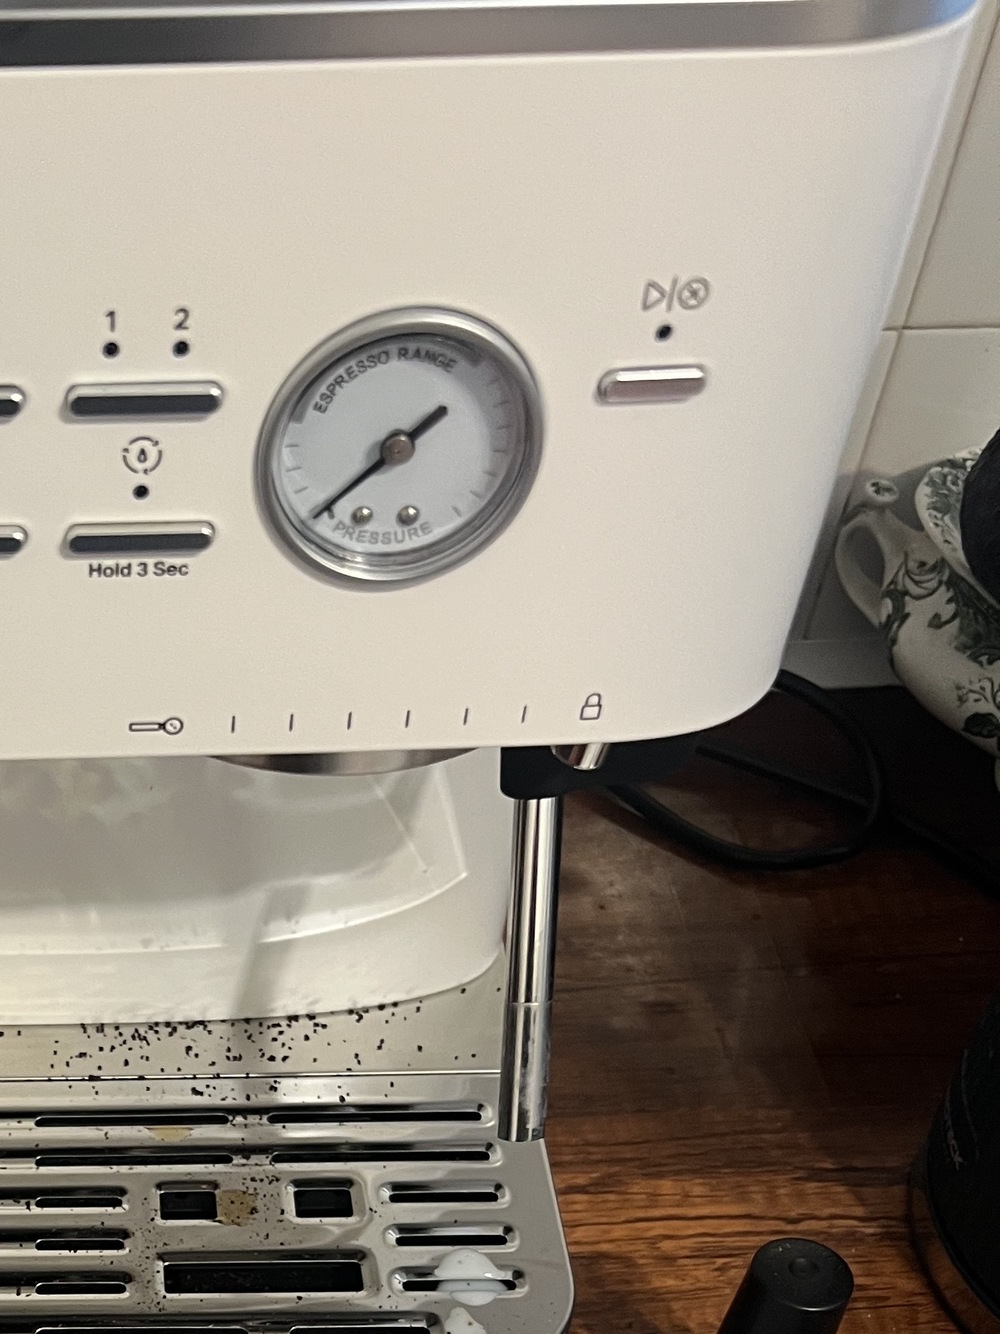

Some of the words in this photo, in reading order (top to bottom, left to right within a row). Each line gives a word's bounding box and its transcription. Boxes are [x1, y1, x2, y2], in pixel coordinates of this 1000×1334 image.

[105, 311, 117, 332] 1
[174, 308, 190, 331] 2
[313, 350, 390, 415] ESPRESSO
[397, 347, 457, 373] RANGE
[333, 520, 433, 545] PRESSURE
[88, 561, 132, 578] Hold
[136, 562, 149, 578] 3
[153, 561, 190, 578] Sec
